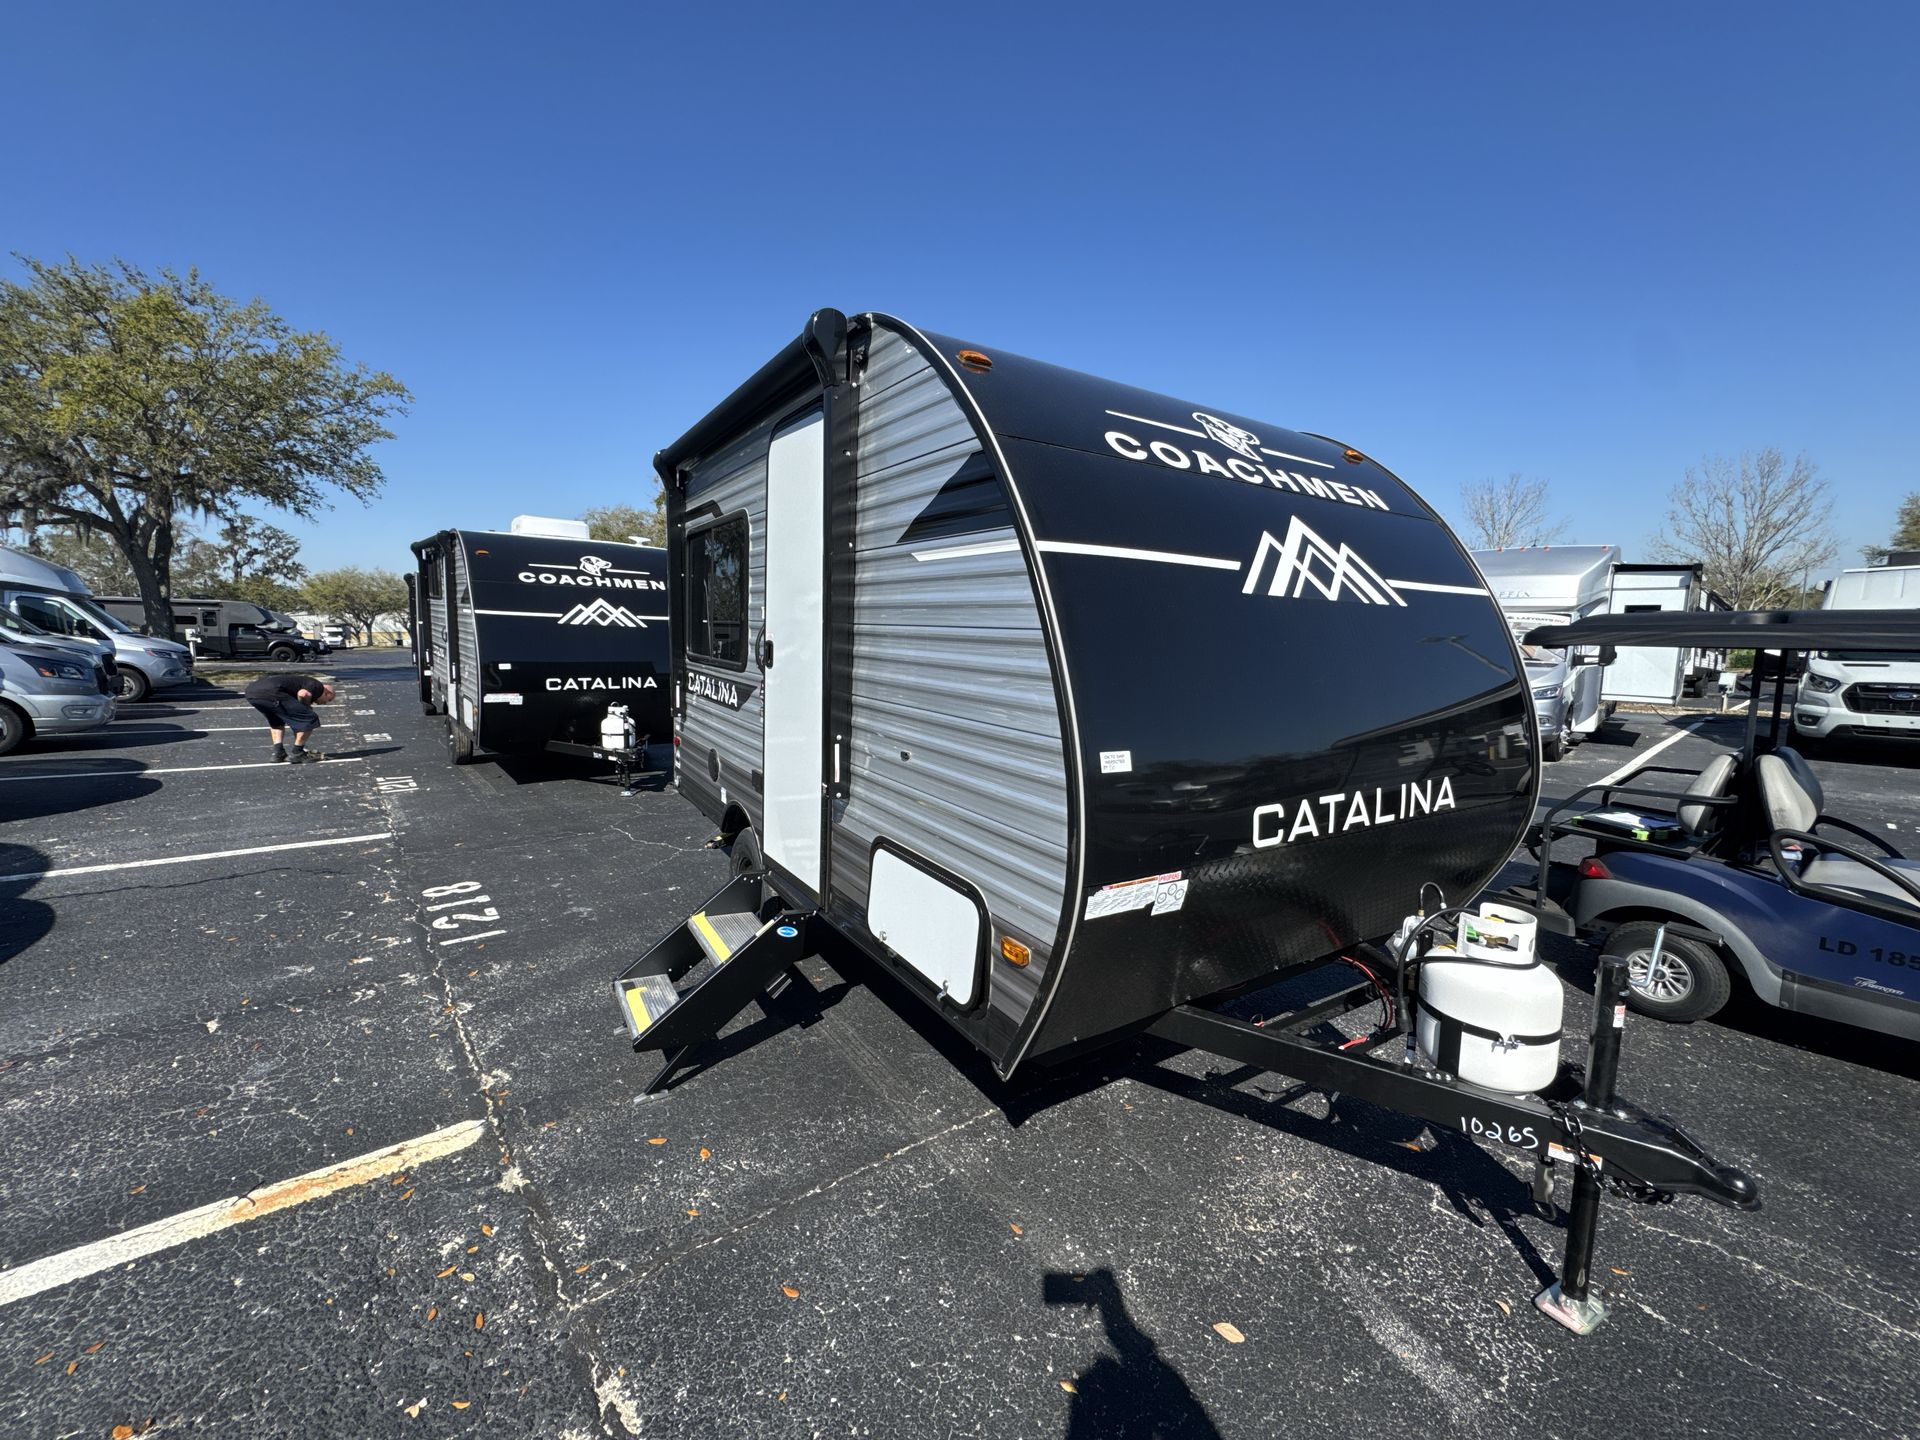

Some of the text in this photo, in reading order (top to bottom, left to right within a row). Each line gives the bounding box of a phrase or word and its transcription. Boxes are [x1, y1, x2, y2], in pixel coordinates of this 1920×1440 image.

[1104, 431, 1390, 511] COACHMEN
[518, 572, 666, 590] COACHMEN
[545, 676, 658, 691] CATALINA
[688, 672, 738, 707] CATALINA
[1253, 777, 1456, 848] CATALINA
[421, 881, 507, 946] 1218
[1819, 936, 1857, 956] LD
[1461, 1116, 1539, 1149] 10265
